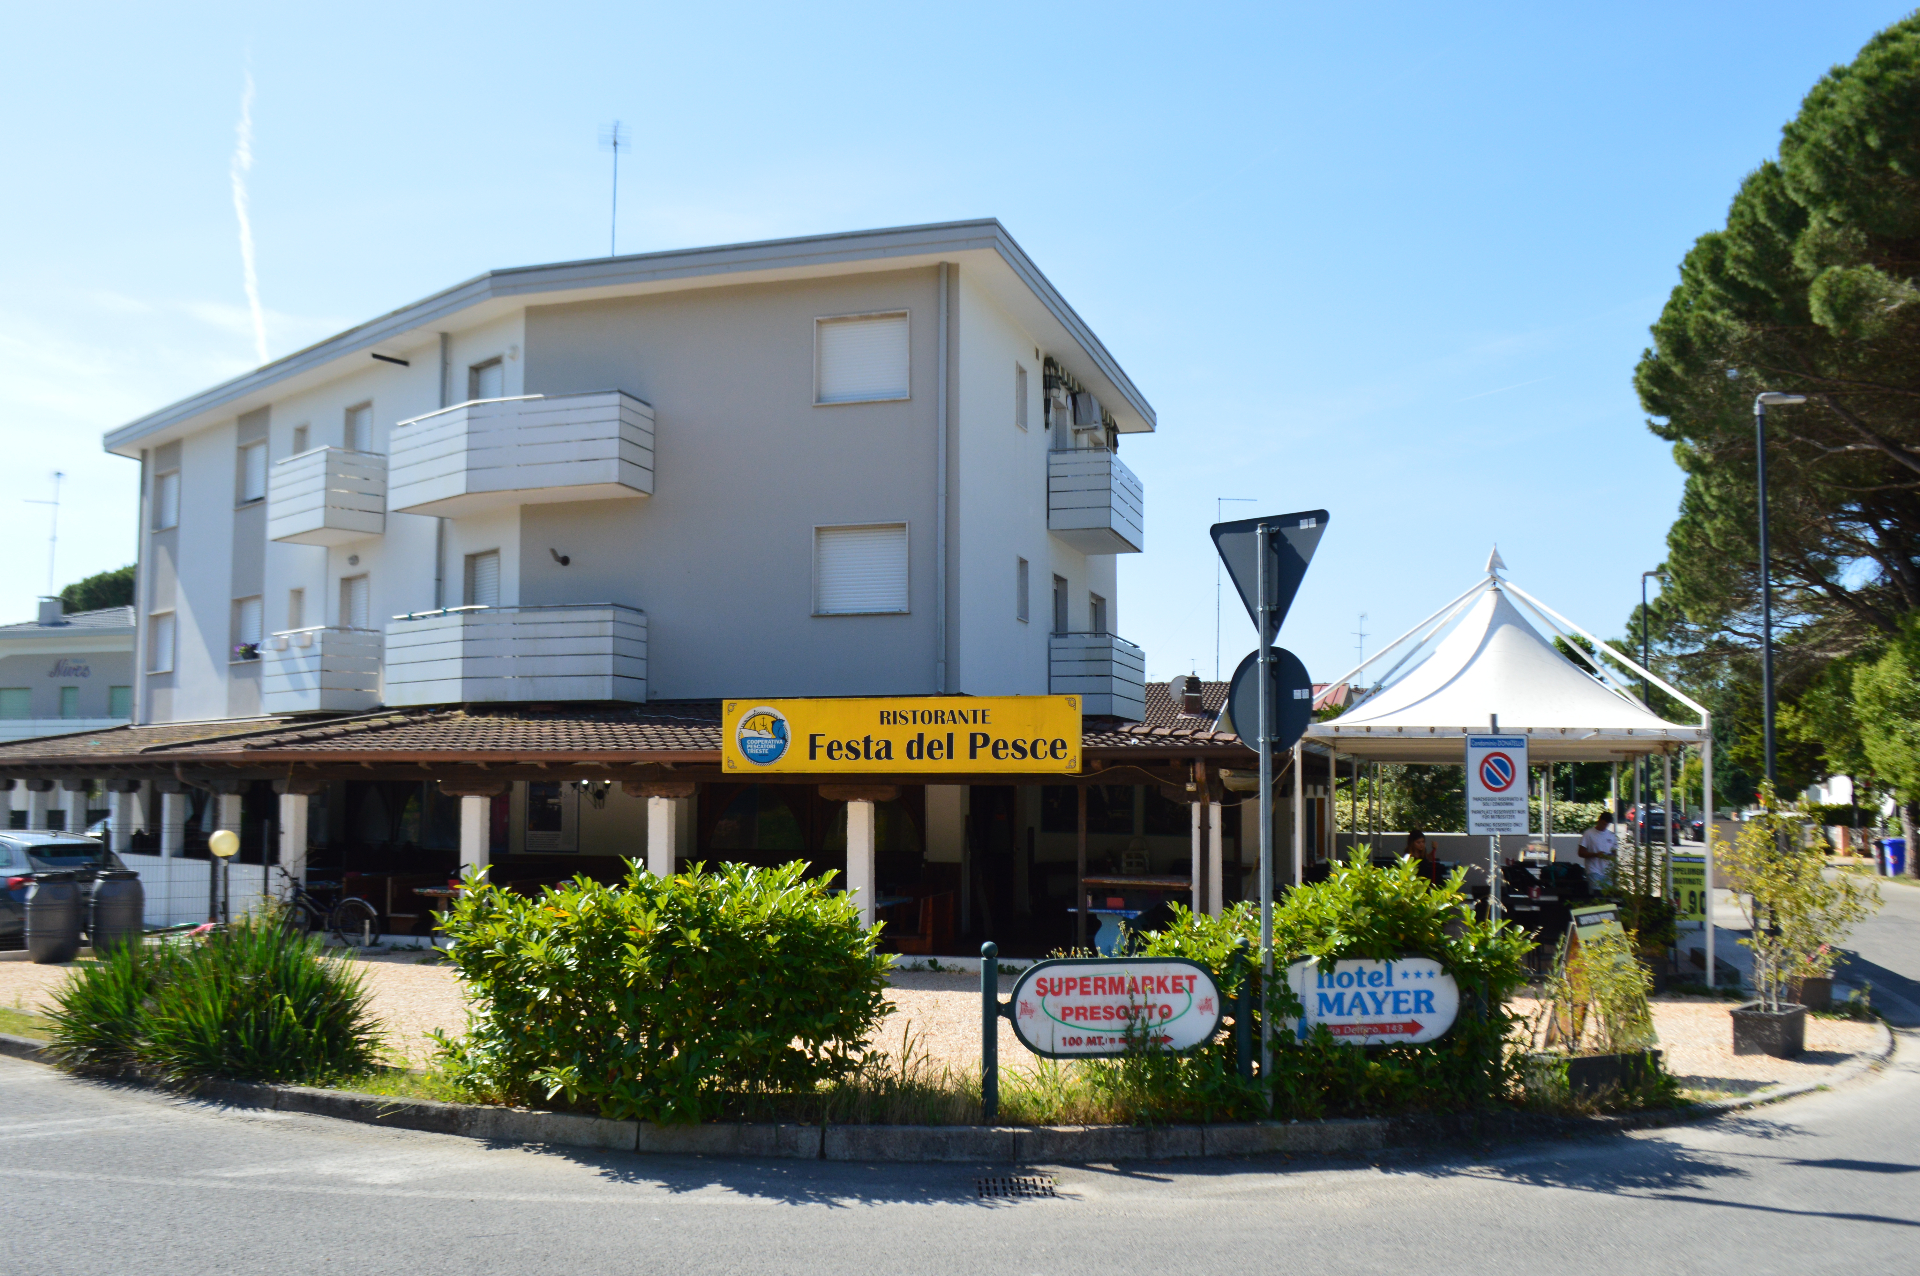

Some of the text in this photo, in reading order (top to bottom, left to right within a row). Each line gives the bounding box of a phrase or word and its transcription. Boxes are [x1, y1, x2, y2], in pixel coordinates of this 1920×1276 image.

[879, 709, 992, 726] RISTORANTE
[808, 732, 1068, 761] Festa del Pesce
[1035, 975, 1198, 997] SUPERMARKET
[1316, 962, 1394, 989] hotel
[1061, 1004, 1173, 1022] PRESOTTO
[1316, 990, 1436, 1017] MAYER
[1061, 1036, 1083, 1047] 100
